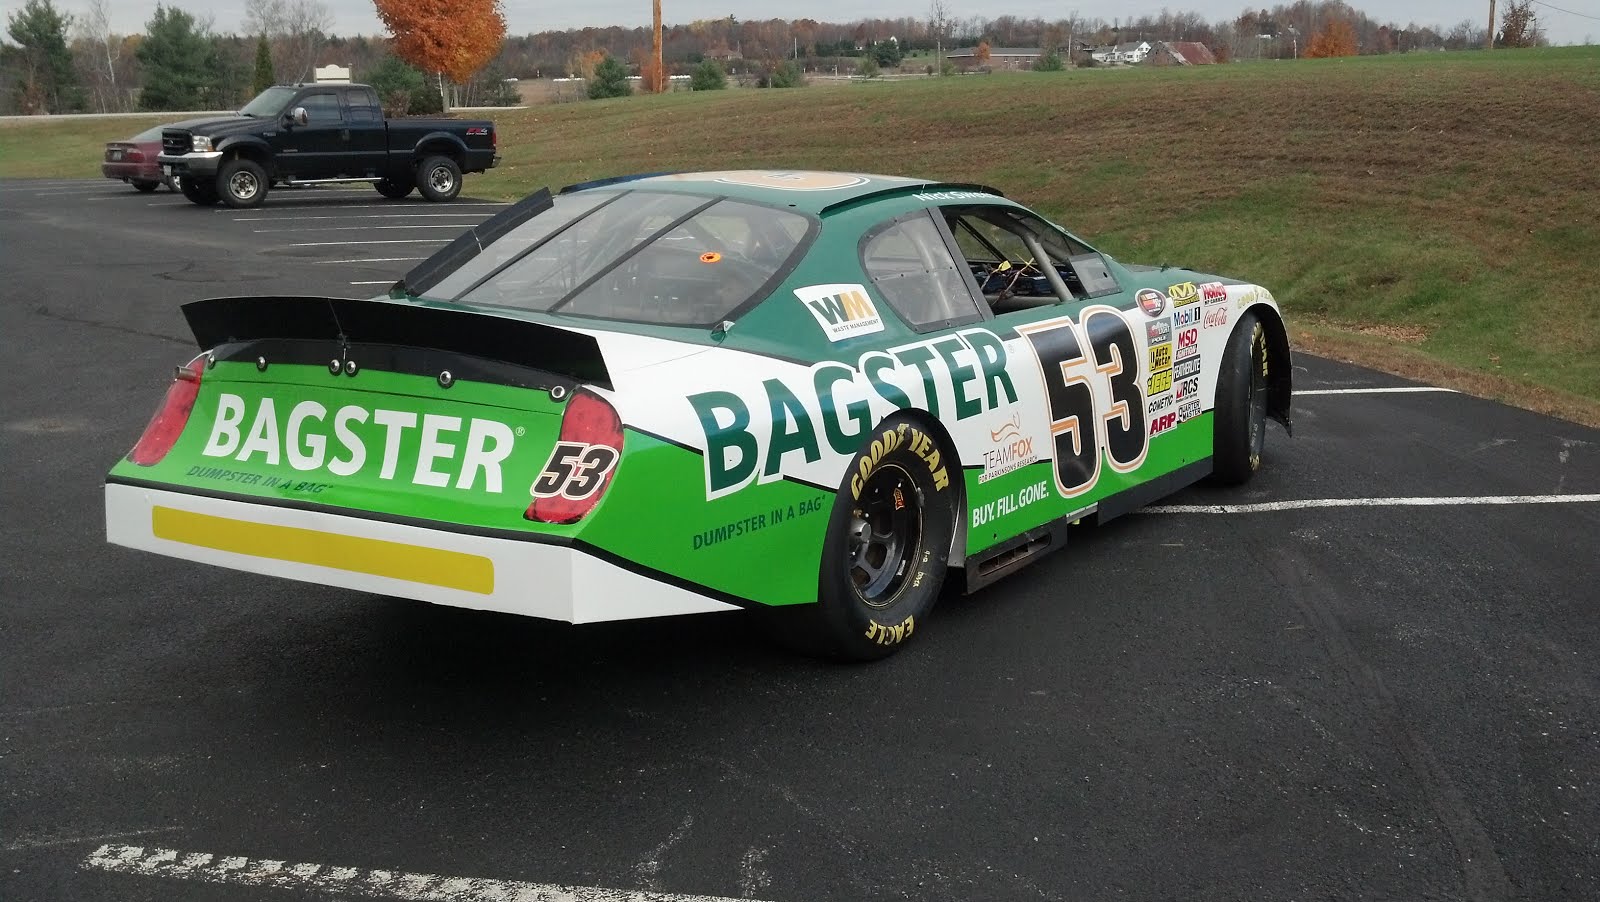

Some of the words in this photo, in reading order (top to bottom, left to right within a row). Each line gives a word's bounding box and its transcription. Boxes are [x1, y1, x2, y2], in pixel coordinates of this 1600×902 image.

[911, 192, 954, 201] Nick
[1201, 284, 1226, 301] Holley
[808, 290, 876, 326] WM
[1173, 308, 1193, 327] Mobil
[832, 324, 850, 334] WASTE
[850, 318, 880, 330] MANAGEMENT
[1177, 328, 1198, 350] MSD
[1154, 355, 1171, 370] Meter
[1155, 347, 1169, 358] Auto
[1174, 358, 1200, 379] FEATHERLITE
[1147, 368, 1172, 397] JEGS
[684, 330, 1020, 497] BAGSTER
[1014, 304, 1150, 499] 53
[1148, 394, 1174, 414] COMETIC
[1178, 400, 1200, 417] QUARTER
[1150, 411, 1176, 435] ARP
[1182, 408, 1201, 422] MASTER
[202, 393, 514, 493] BAGSTER
[186, 465, 262, 485] DUMPSTER
[261, 476, 280, 488] IN
[278, 479, 293, 490] A
[530, 441, 620, 501] 53
[979, 474, 988, 483] FOR
[1017, 455, 1038, 468] RESEARCH
[972, 501, 995, 528] BUY.
[997, 494, 1018, 518] FILL.
[1019, 480, 1049, 508] GONE.
[693, 514, 767, 550] DUMPSTER
[771, 508, 783, 526] IN
[787, 505, 795, 520] A
[865, 615, 915, 646] EAGLE
